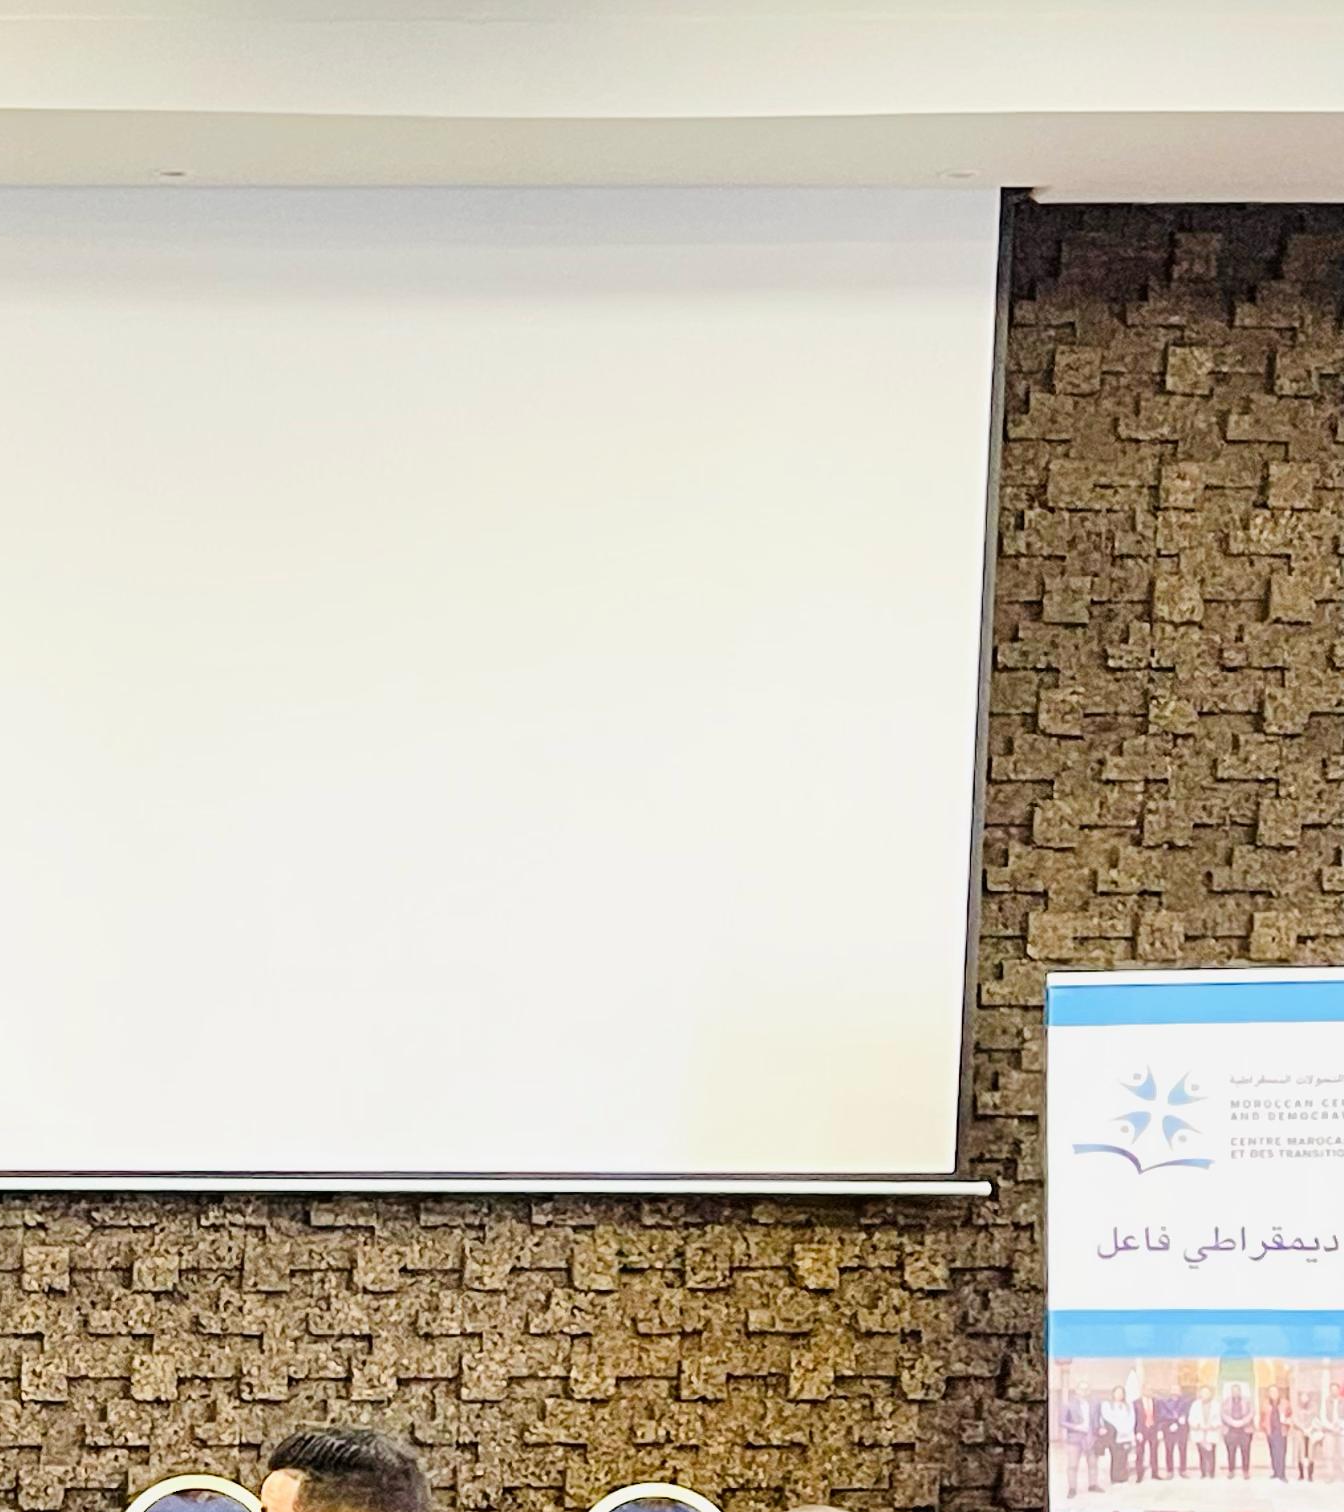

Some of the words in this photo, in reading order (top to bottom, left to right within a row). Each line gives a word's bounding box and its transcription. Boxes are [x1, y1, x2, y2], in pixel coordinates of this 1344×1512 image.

[1230, 1099, 1313, 1109] MOROCCAN
[1230, 1111, 1260, 1121] AND
[1230, 1136, 1281, 1147] CENTRE
[1230, 1149, 1245, 1160] ET
[1249, 1149, 1275, 1159] DES
[1097, 1226, 1171, 1260] فاعل
